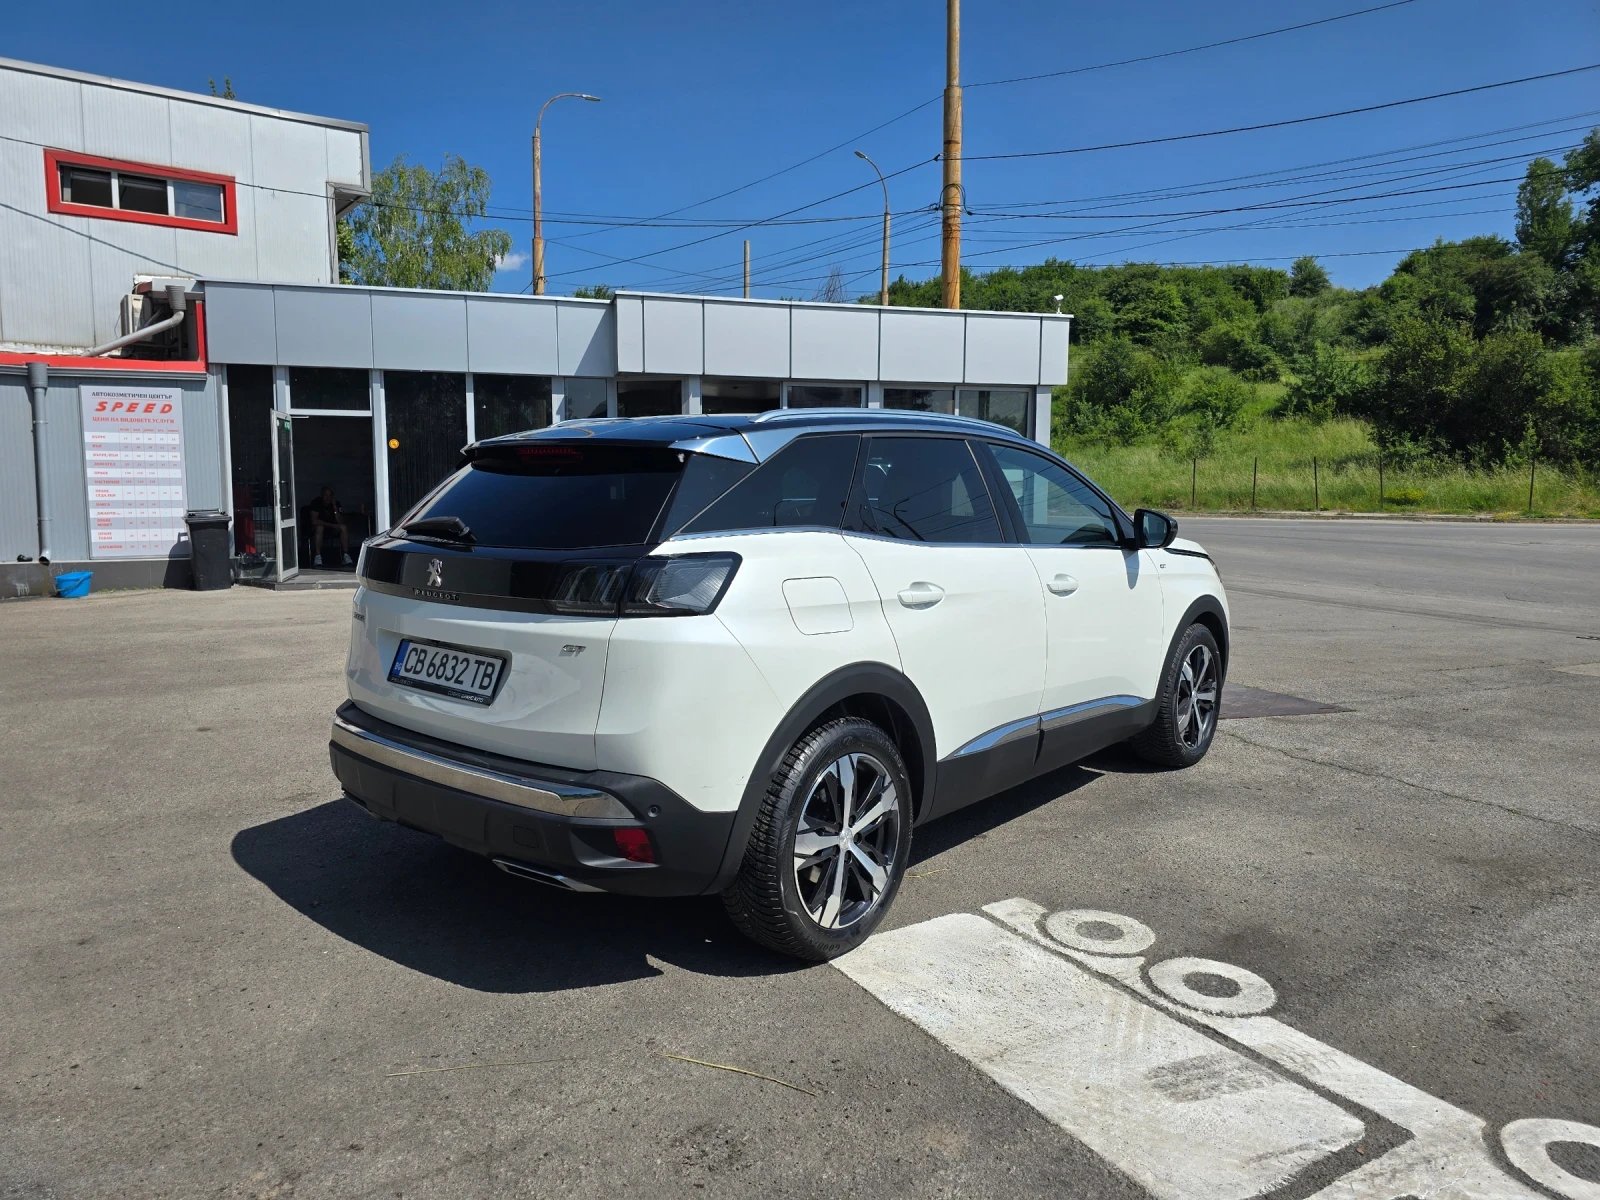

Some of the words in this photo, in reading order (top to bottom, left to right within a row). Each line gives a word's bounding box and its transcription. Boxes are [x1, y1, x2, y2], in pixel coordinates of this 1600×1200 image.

[92, 391, 148, 399] АВТОКОЗМЕТИЧЕН
[94, 401, 173, 414] SPEED
[414, 589, 457, 600] PEUGEOT
[562, 644, 587, 653] GT
[426, 651, 470, 686] 6832
